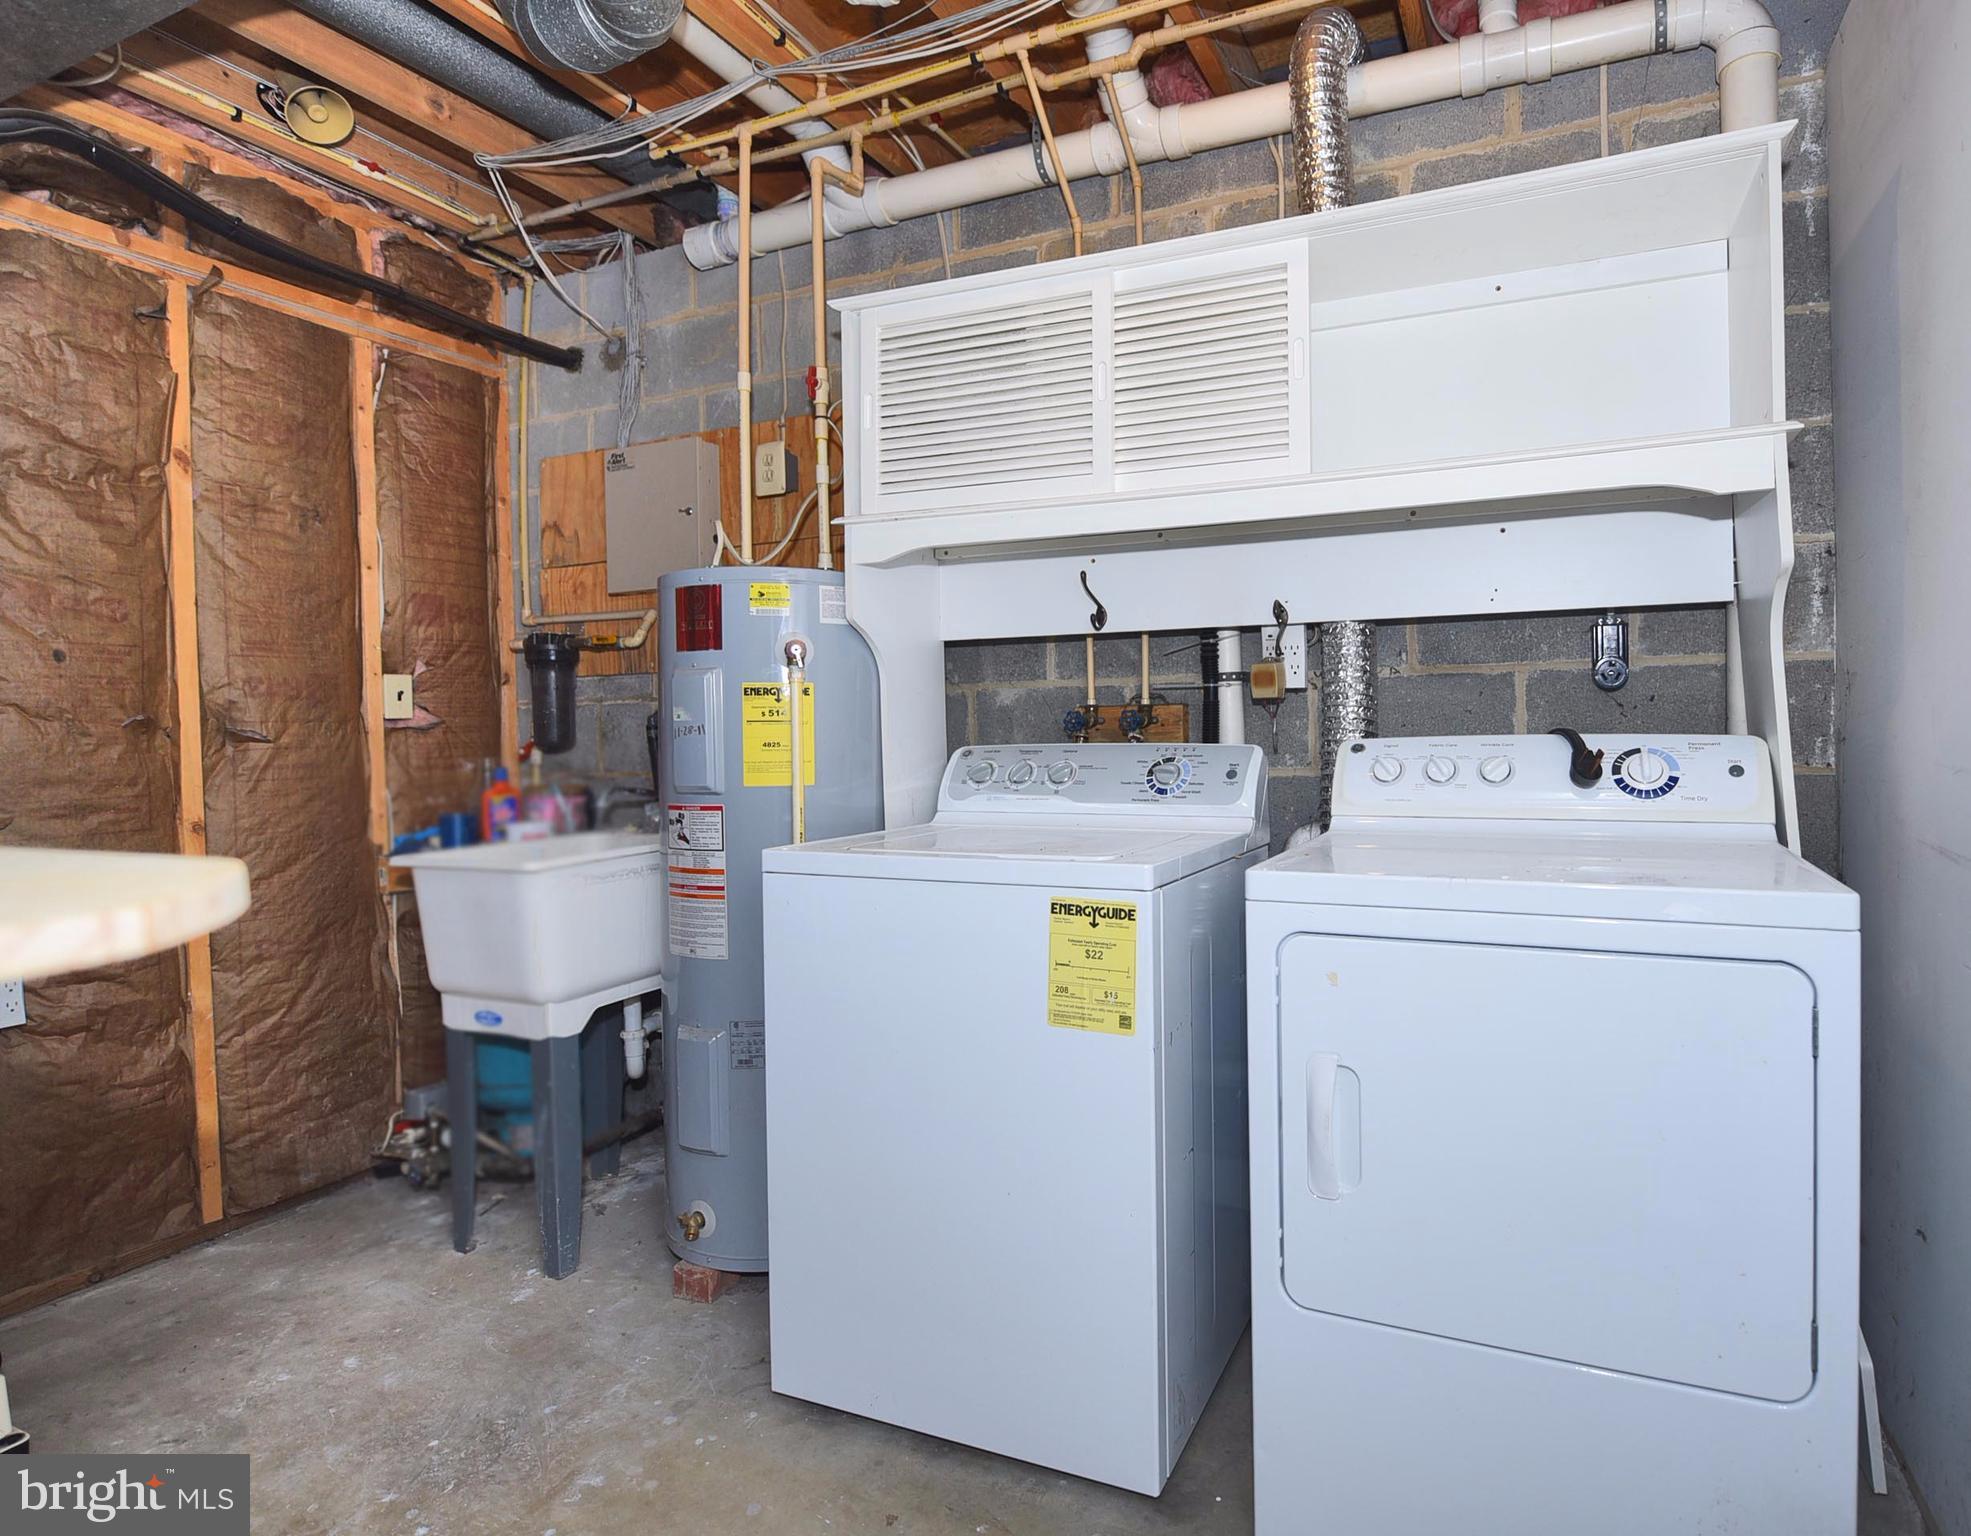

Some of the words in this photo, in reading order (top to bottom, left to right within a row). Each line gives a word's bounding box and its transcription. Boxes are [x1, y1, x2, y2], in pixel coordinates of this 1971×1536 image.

[762, 741, 781, 749] 4825
[1050, 902, 1136, 922] ENERGYGUIDE
[1084, 949, 1104, 961] $22
